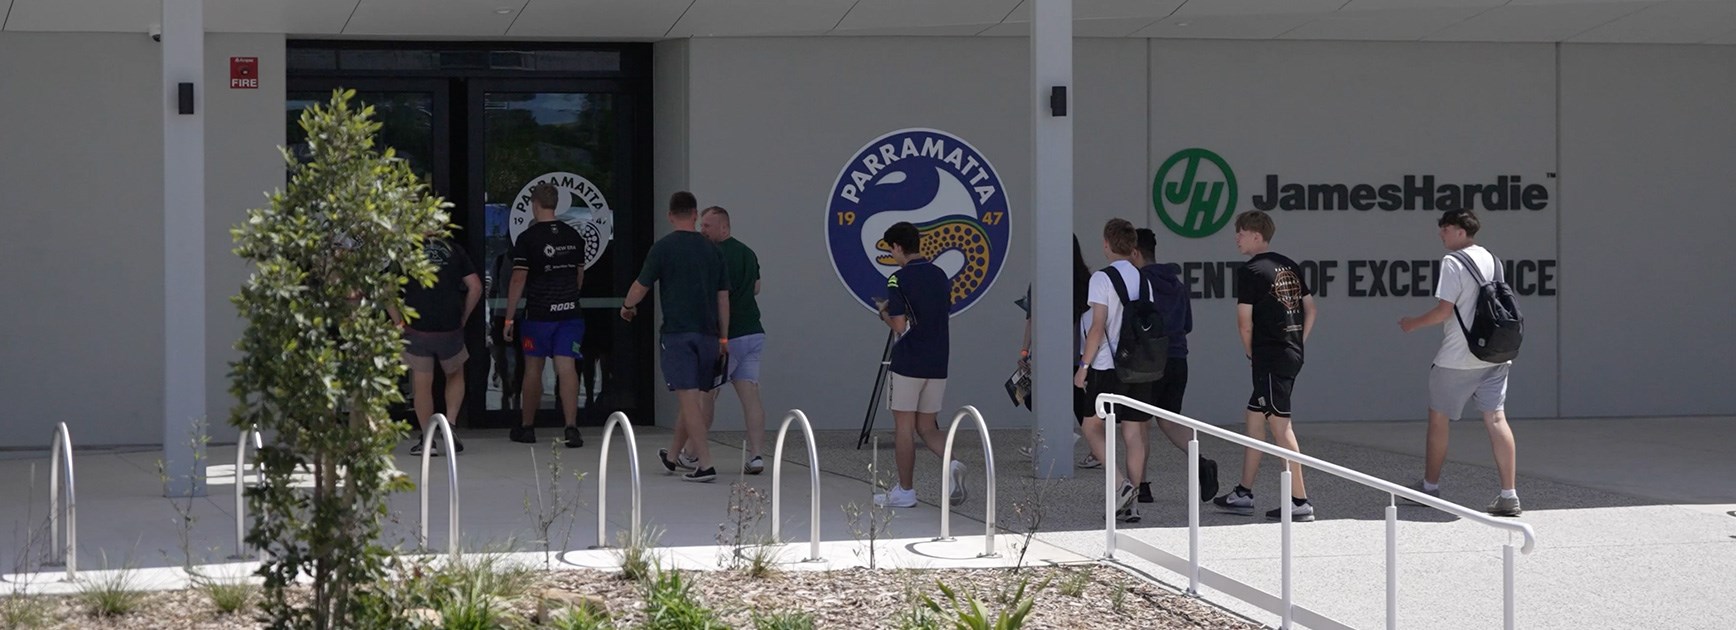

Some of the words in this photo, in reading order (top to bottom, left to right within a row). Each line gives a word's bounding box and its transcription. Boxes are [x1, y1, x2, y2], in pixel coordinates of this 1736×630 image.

[232, 78, 257, 87] FIRE
[841, 137, 995, 205] PARRAMATTA
[1164, 151, 1226, 235] JH
[514, 217, 524, 225] 19
[837, 211, 856, 226] 19
[982, 211, 1003, 226] 47
[1300, 260, 1338, 298] OF
[550, 301, 576, 312] ROOS
